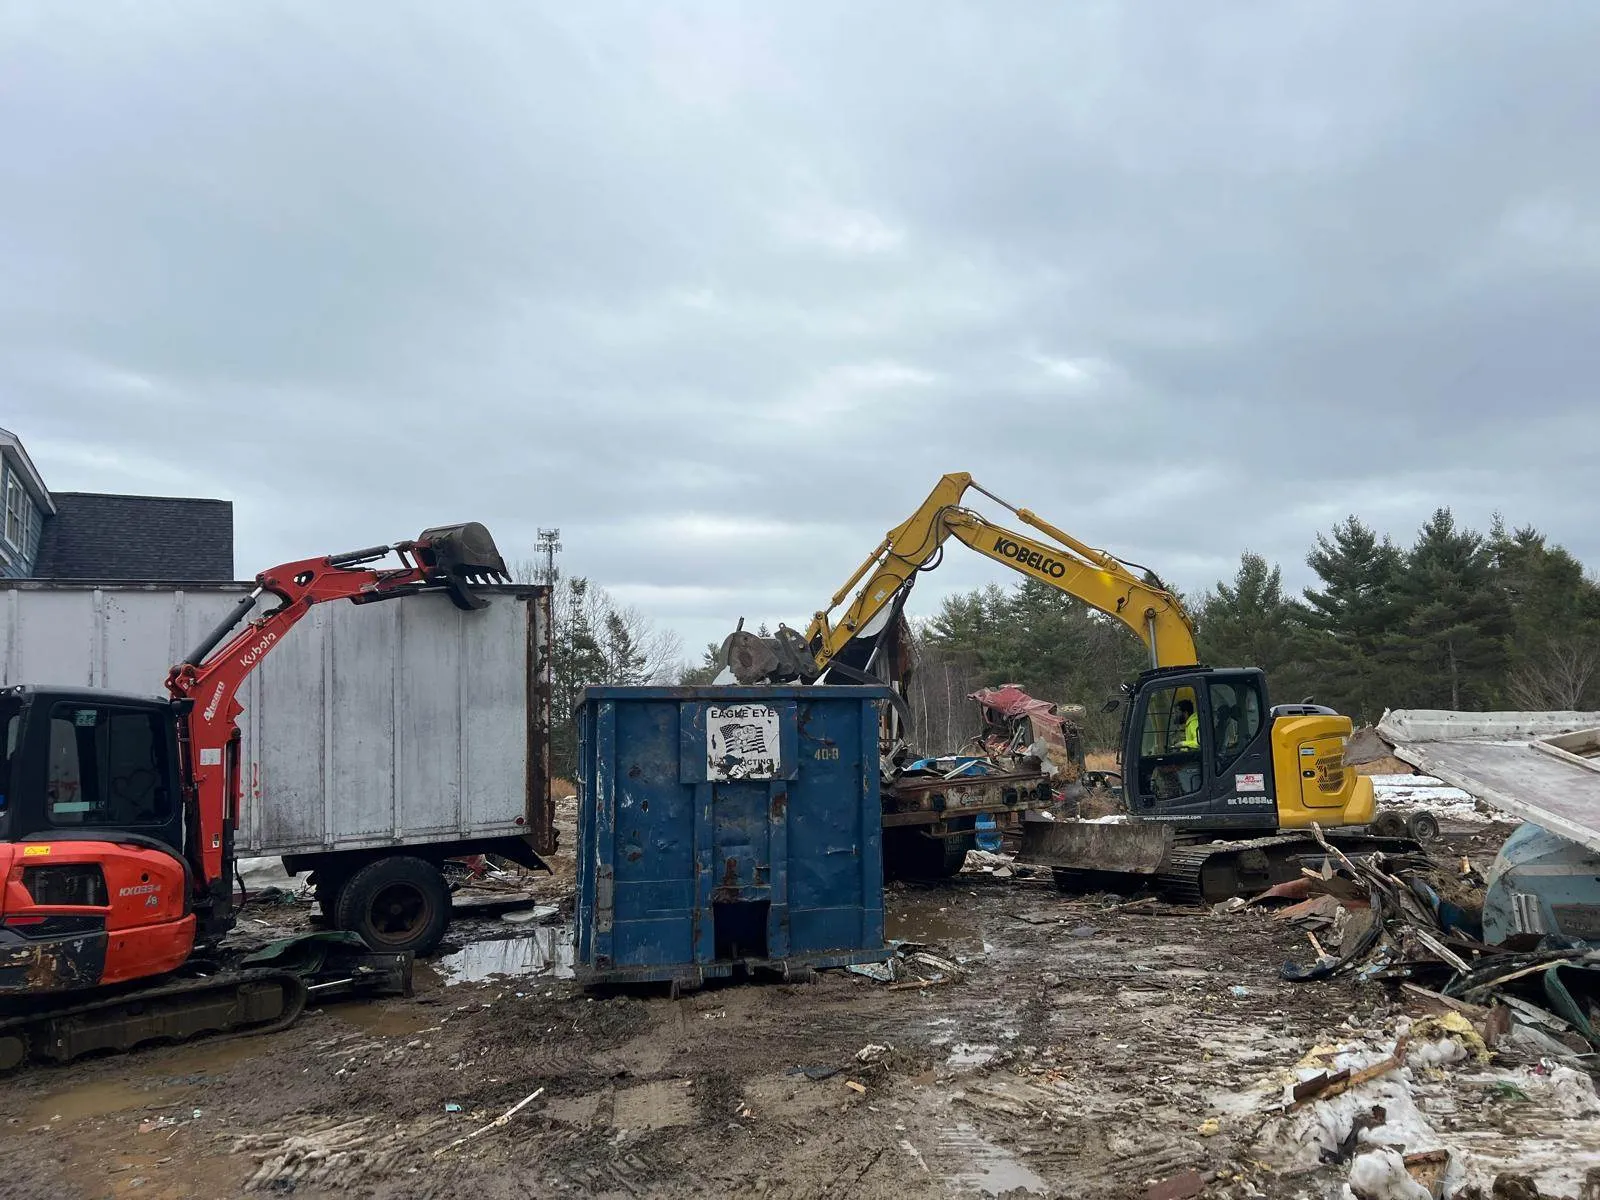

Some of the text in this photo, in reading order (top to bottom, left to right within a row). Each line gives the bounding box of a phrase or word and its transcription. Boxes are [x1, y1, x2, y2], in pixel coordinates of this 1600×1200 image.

[993, 536, 1065, 578] KOBELCO
[240, 632, 277, 667] Kubota
[711, 708, 775, 719] EAGLE EYE
